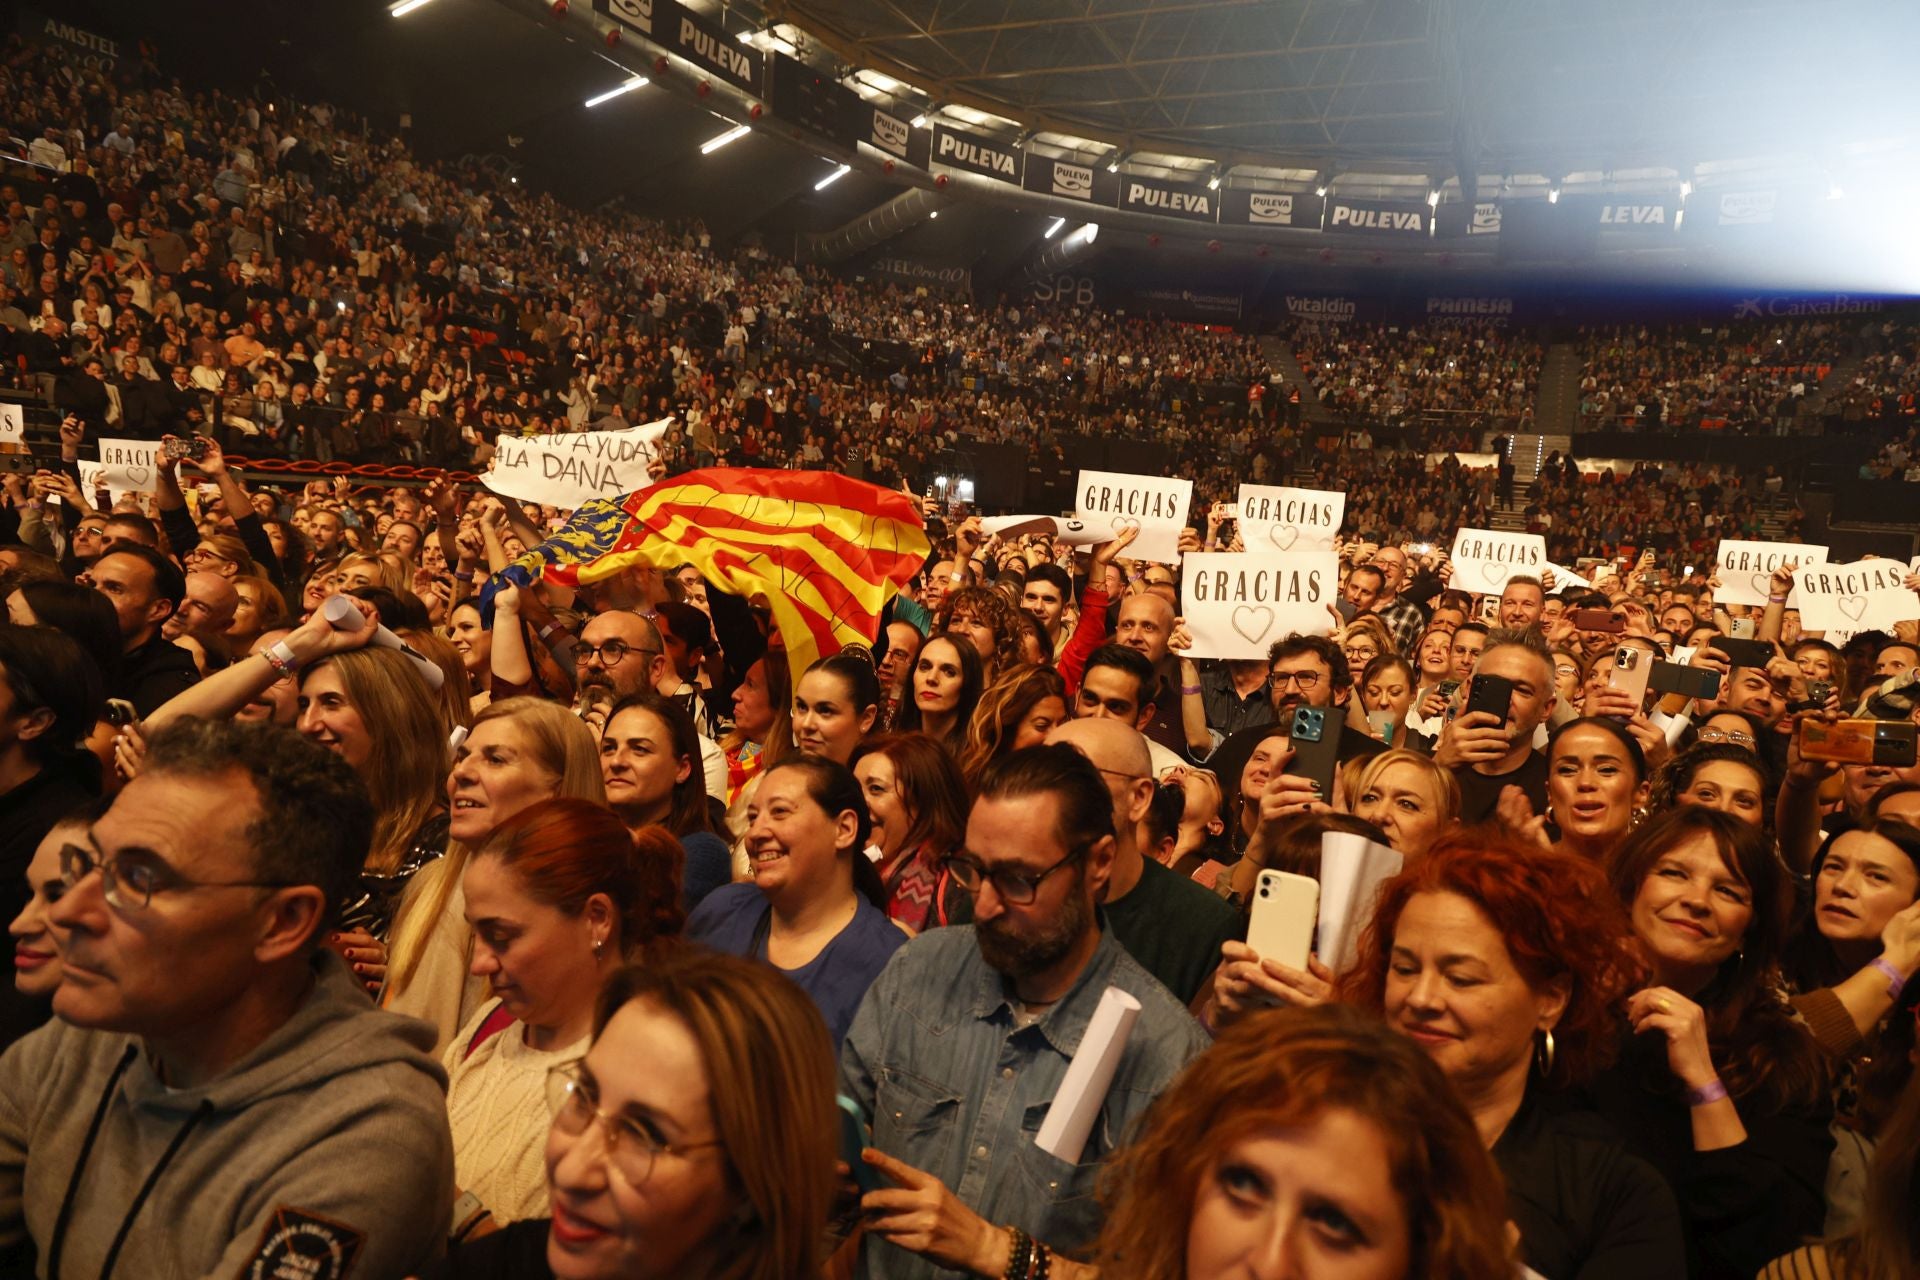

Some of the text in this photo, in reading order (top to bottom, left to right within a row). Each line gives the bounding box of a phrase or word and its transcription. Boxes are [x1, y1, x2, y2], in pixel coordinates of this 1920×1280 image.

[44, 18, 119, 58] AMSTEL
[680, 16, 752, 82] PULEVA
[875, 114, 906, 138] PULEVA
[939, 133, 1015, 175] PULEVA
[1056, 166, 1090, 182] PULEVA
[1128, 183, 1210, 214] PULEVA
[1253, 196, 1290, 208] PULEVA
[1332, 205, 1422, 231] PULEVA
[872, 258, 910, 276] STEL
[1034, 275, 1094, 305] SPB
[1286, 296, 1355, 313] Vitaldin
[1427, 297, 1512, 313] PAMESA
[1767, 294, 1883, 317] CaixaBan
[573, 433, 651, 463] AYUDA
[505, 447, 529, 468] LA
[542, 452, 624, 494] DANA
[1085, 485, 1178, 519] GRACIAS
[1245, 496, 1332, 526] GRACIAS
[1460, 538, 1539, 566] GRACIAS
[1194, 570, 1321, 603] GRACIAS
[1804, 566, 1900, 595] GRACIAS
